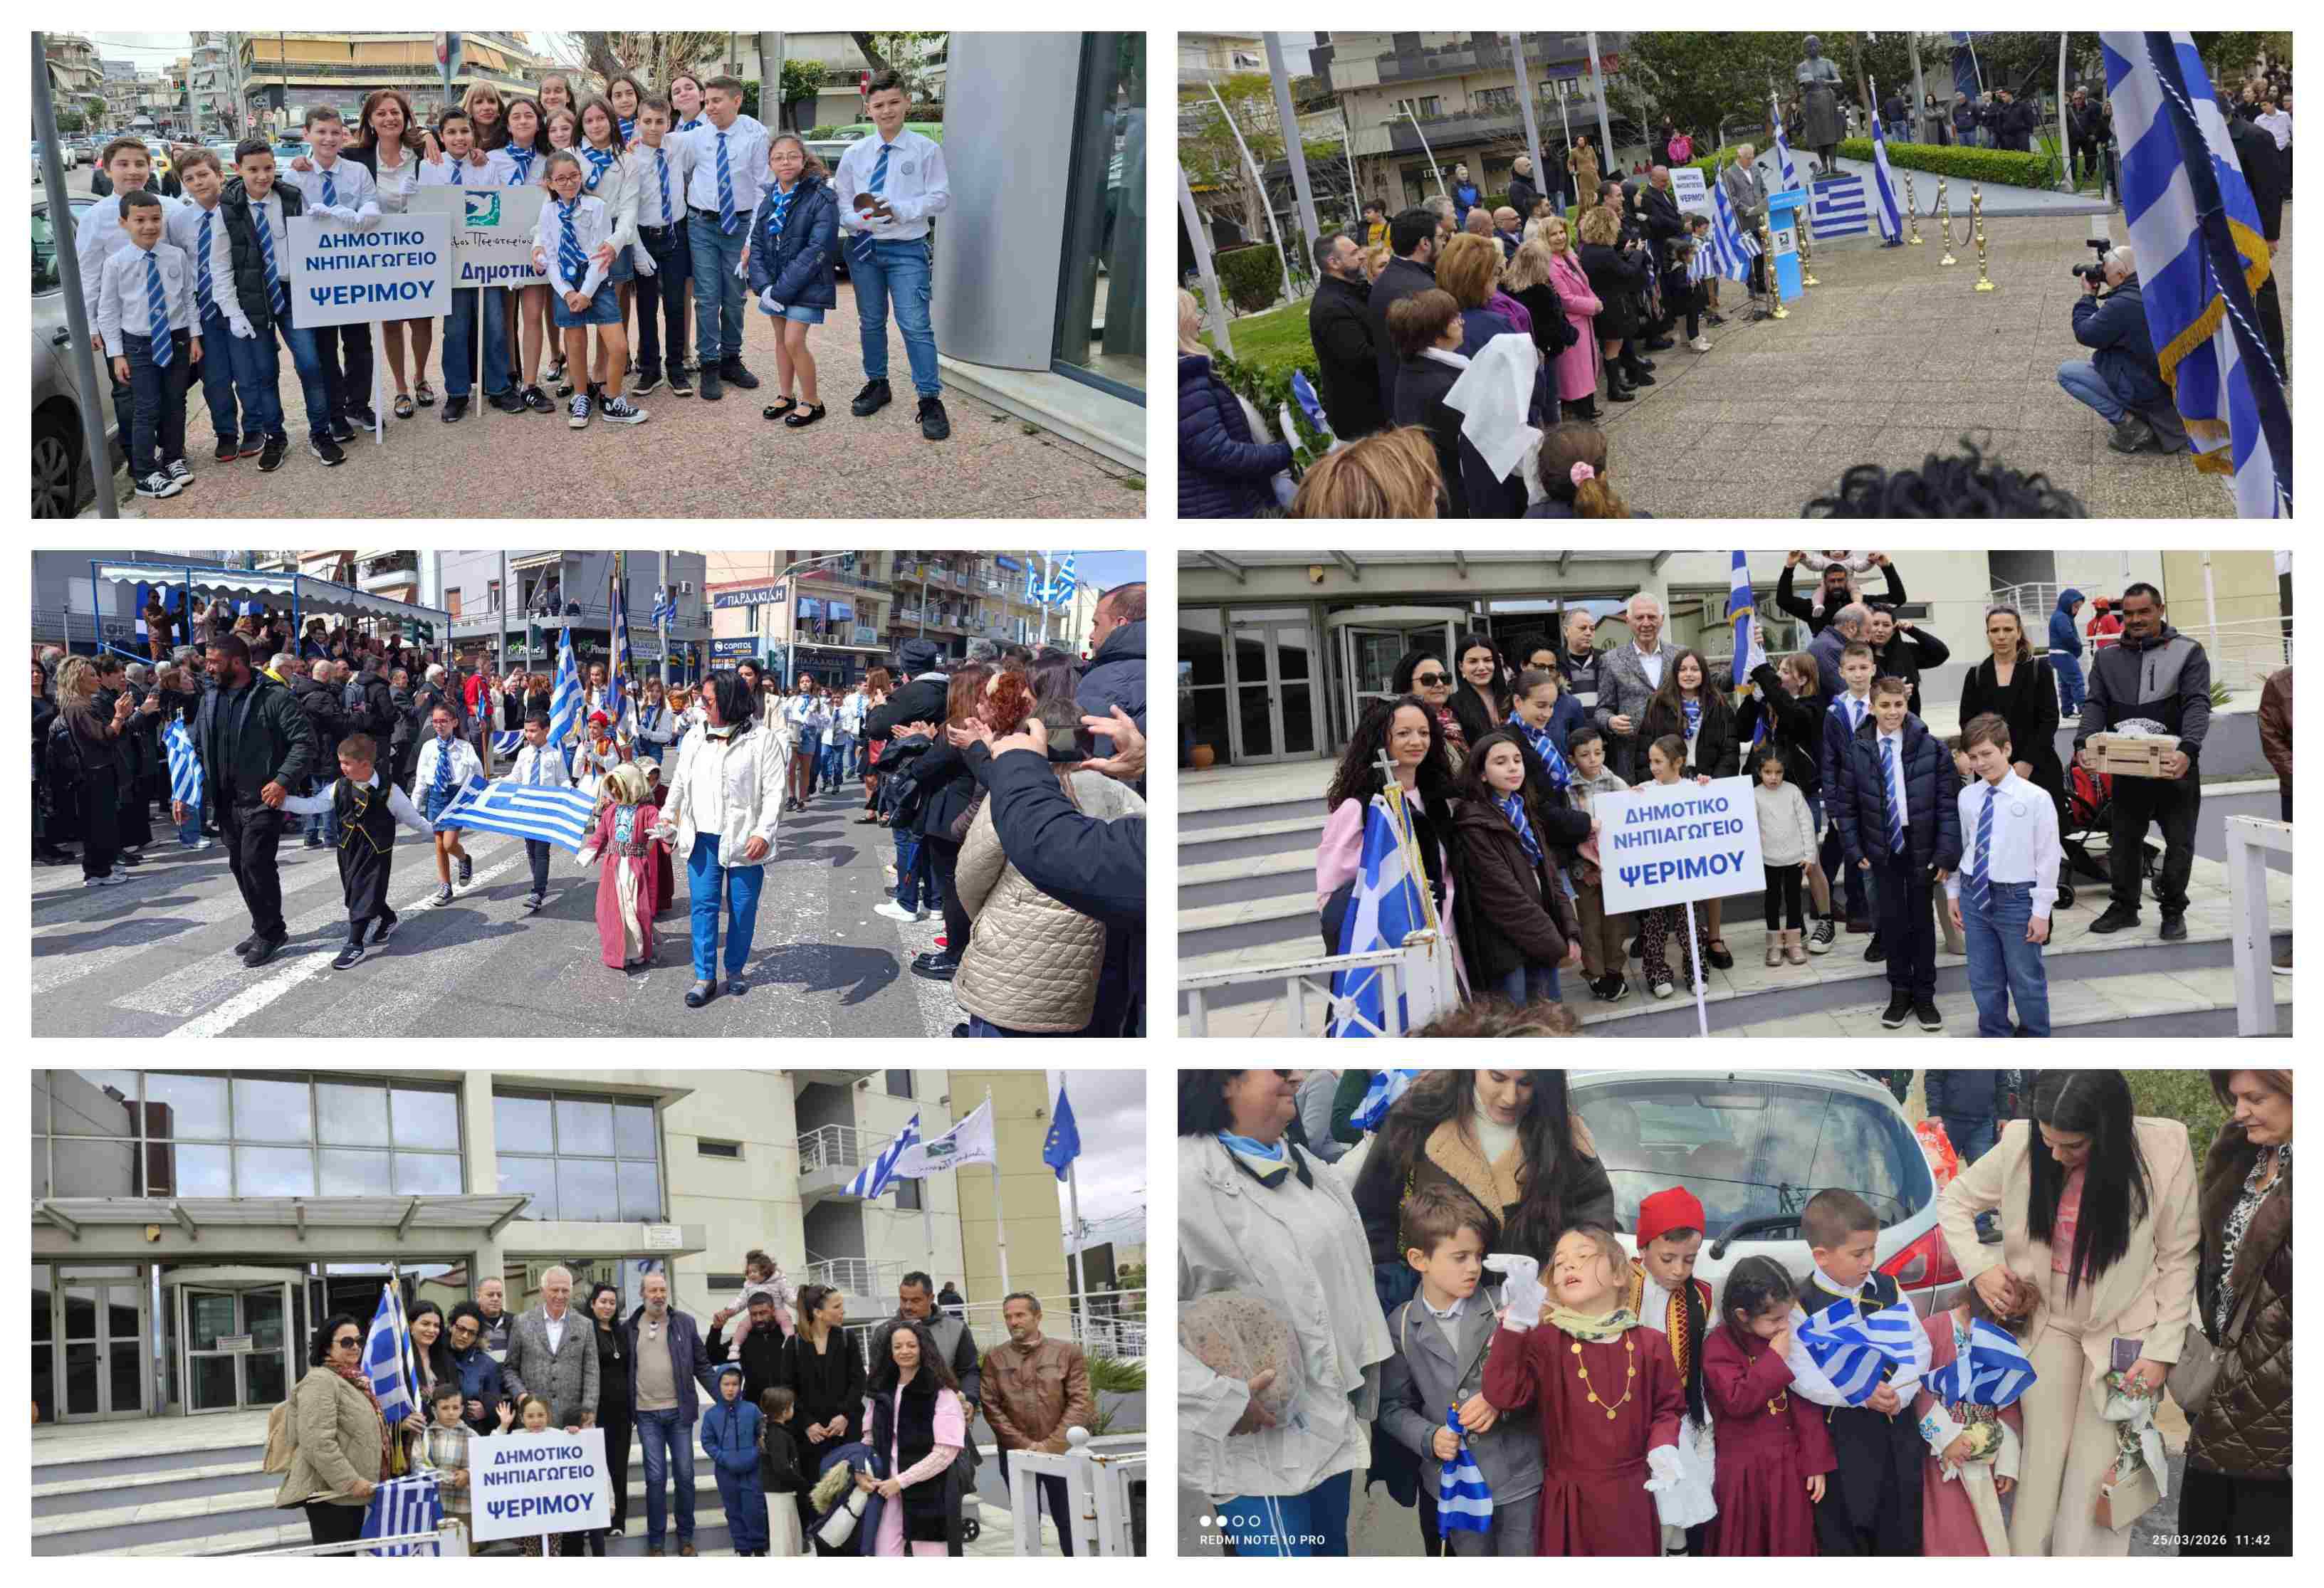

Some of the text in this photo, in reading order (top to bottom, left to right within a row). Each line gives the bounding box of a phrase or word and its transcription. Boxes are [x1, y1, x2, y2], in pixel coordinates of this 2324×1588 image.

[318, 231, 424, 249] ΔΗΜΟΤΙΚΟ
[306, 251, 437, 271] ΝΗΠΙΑΓΩΓΕΙΟ
[310, 280, 434, 306] ΨΕΡΙΜΟΥ
[1625, 796, 1729, 824] ΔΗΜΟΤΙΚΟ
[1613, 819, 1744, 849] ΝΗΠΙΑΓΩΓΕΙΟ
[1619, 851, 1744, 888] ΨΕΡΙΜΟΥ
[494, 1446, 582, 1465] ΔΗΜΟΤΙΚΟ
[483, 1465, 595, 1486] ΝΗΠΙΑΓΩΓΕΙΟ
[487, 1493, 595, 1519] ΨΕΡΙΜΟΥ
